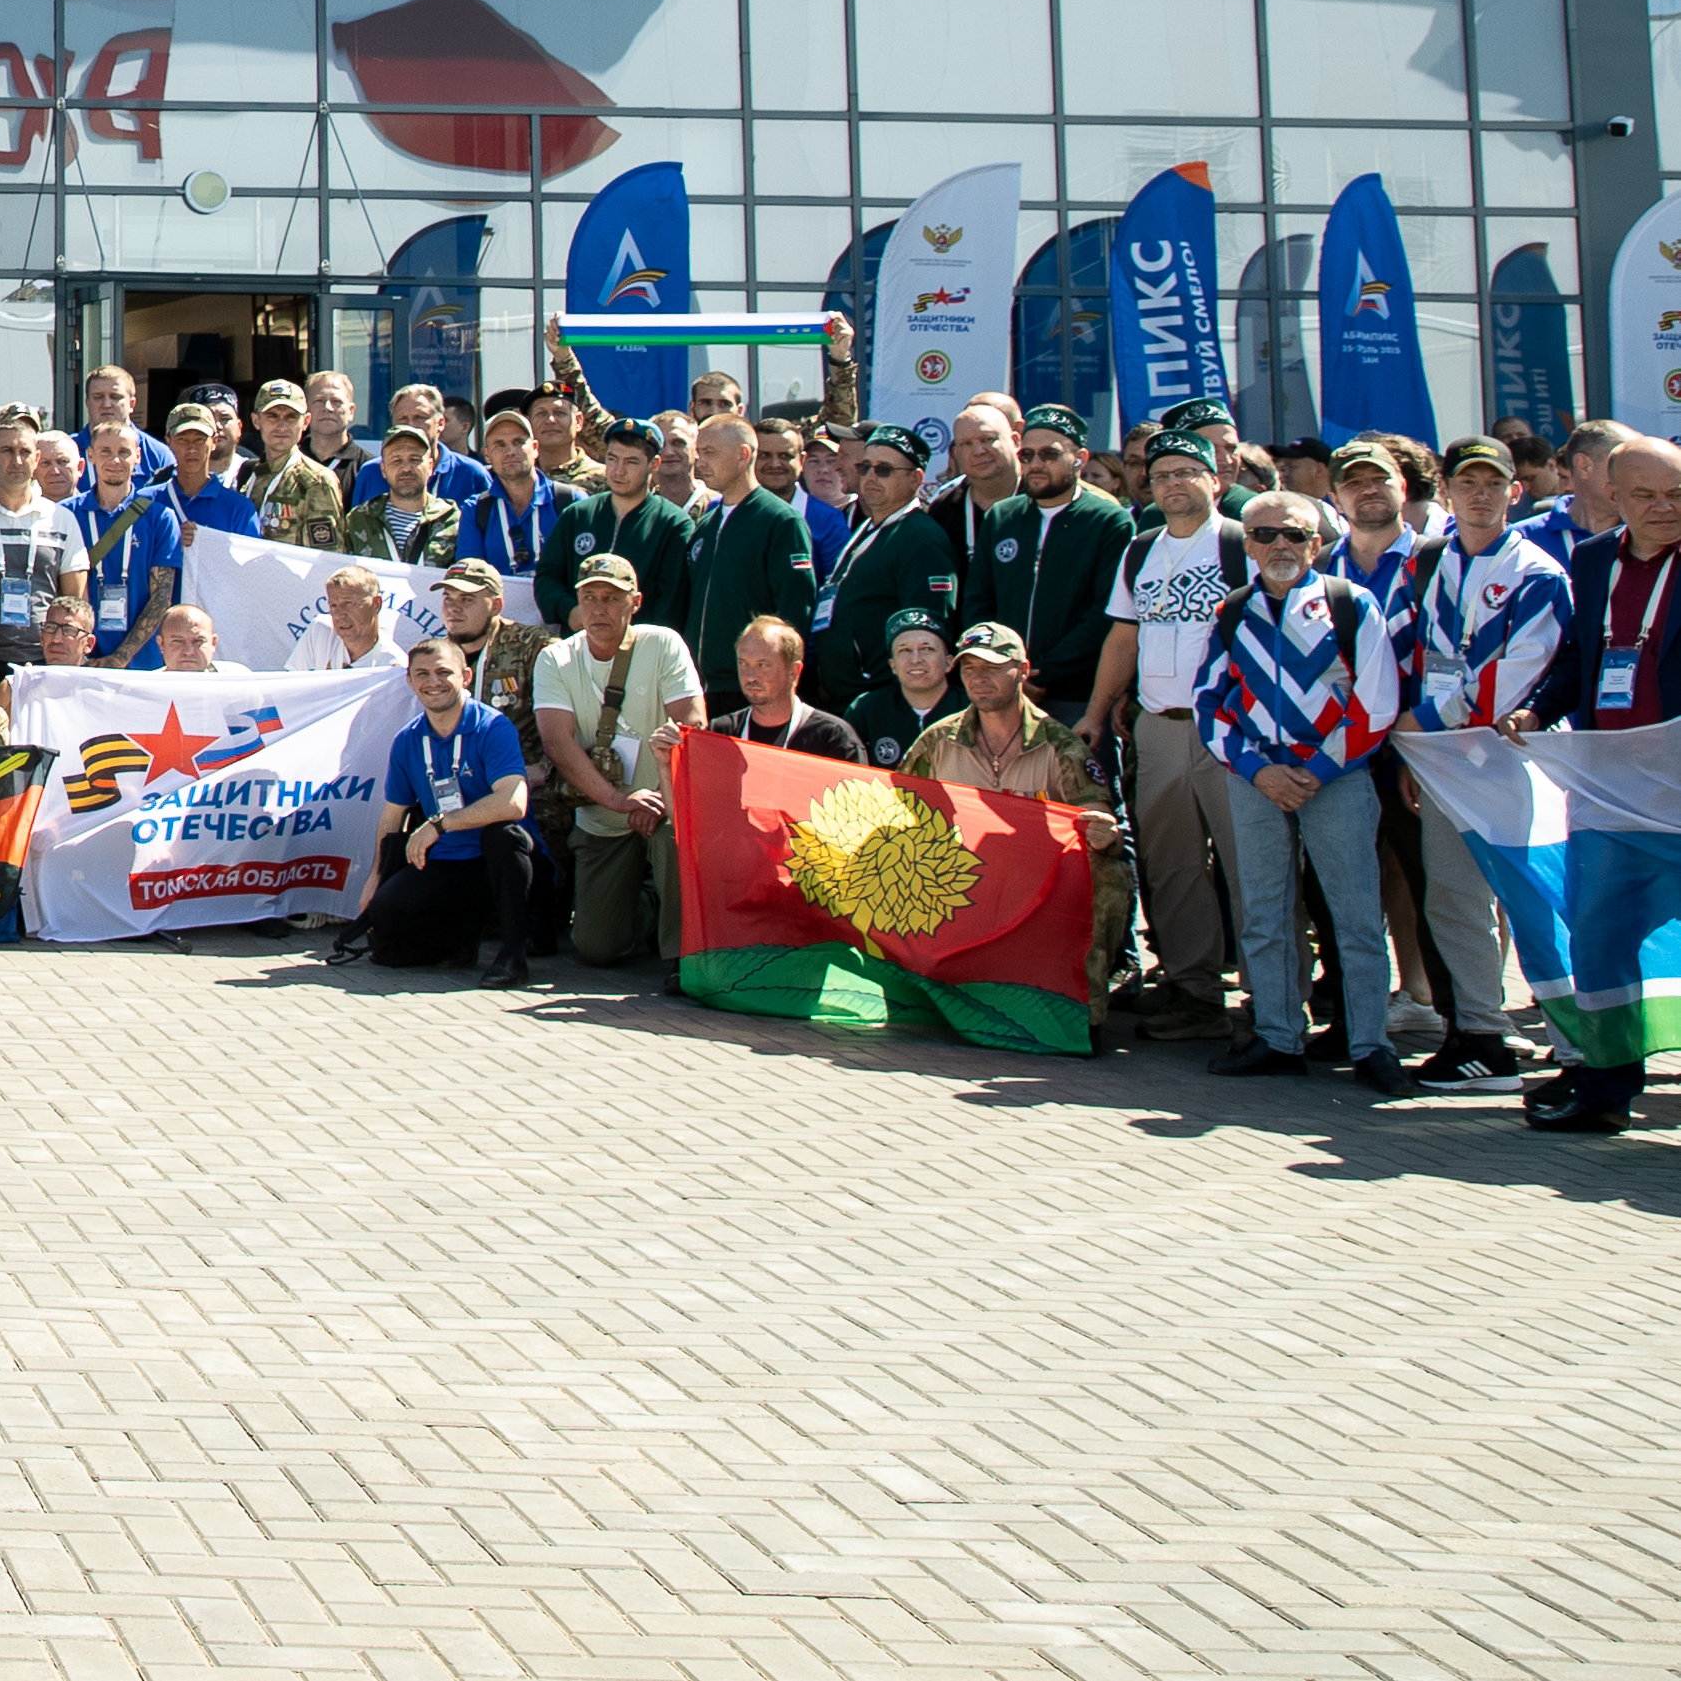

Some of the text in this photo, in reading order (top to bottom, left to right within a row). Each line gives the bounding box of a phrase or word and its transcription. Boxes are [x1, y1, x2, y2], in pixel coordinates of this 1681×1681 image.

[909, 324, 970, 332] ОТЕЧЕСТВА
[1195, 340, 1225, 398] ТВУЙ
[139, 775, 377, 812] ЗАЩИТНИКИ
[131, 807, 333, 845] ОТЕЧЕСТВА
[139, 862, 338, 900] ТОМСКАЯ ОБЛАСТЬ
